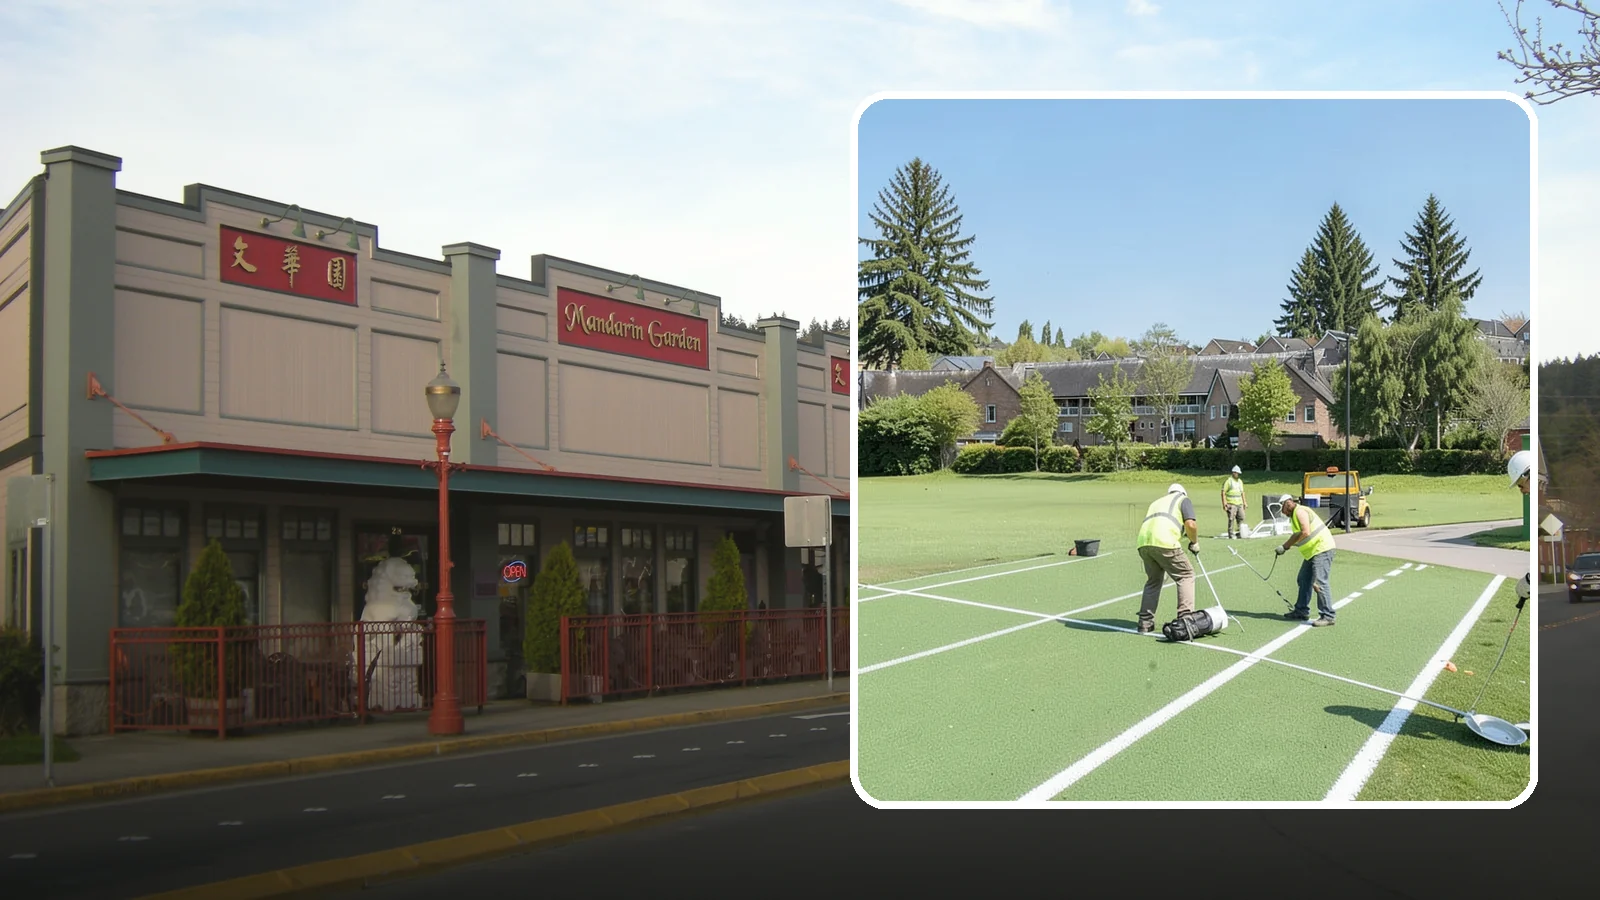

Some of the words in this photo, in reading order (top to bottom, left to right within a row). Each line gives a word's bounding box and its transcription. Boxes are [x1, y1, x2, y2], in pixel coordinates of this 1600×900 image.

[231, 236, 346, 291] 文華園
[565, 302, 644, 341] Mandarin
[648, 320, 702, 352] Garden
[835, 363, 846, 386] 文
[391, 526, 402, 536] 28
[503, 565, 527, 579] OPEN
